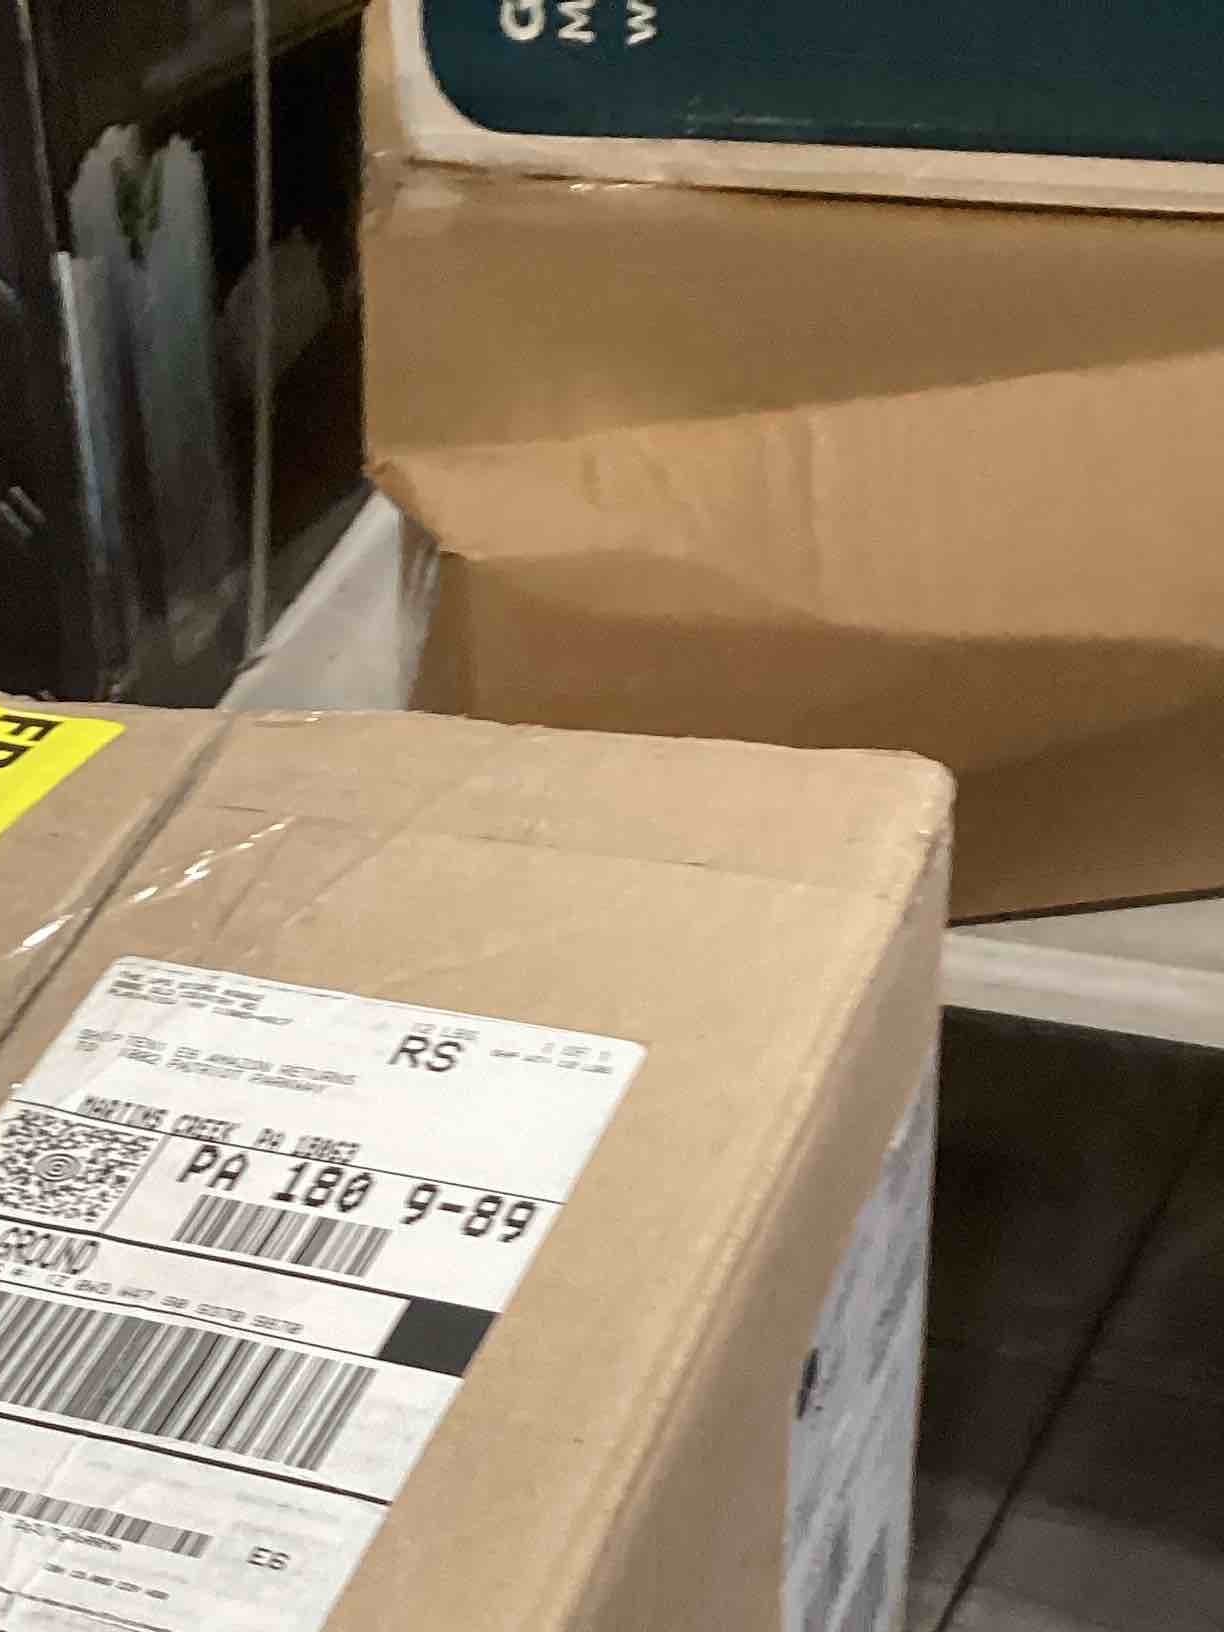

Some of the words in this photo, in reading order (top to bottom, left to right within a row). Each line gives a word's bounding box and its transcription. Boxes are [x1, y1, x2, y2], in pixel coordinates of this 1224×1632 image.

[386, 1034, 466, 1073] RS
[172, 1112, 242, 1142] CREEK
[176, 1145, 250, 1192] PA
[272, 1161, 375, 1214] 180
[400, 1183, 539, 1244] 9-89
